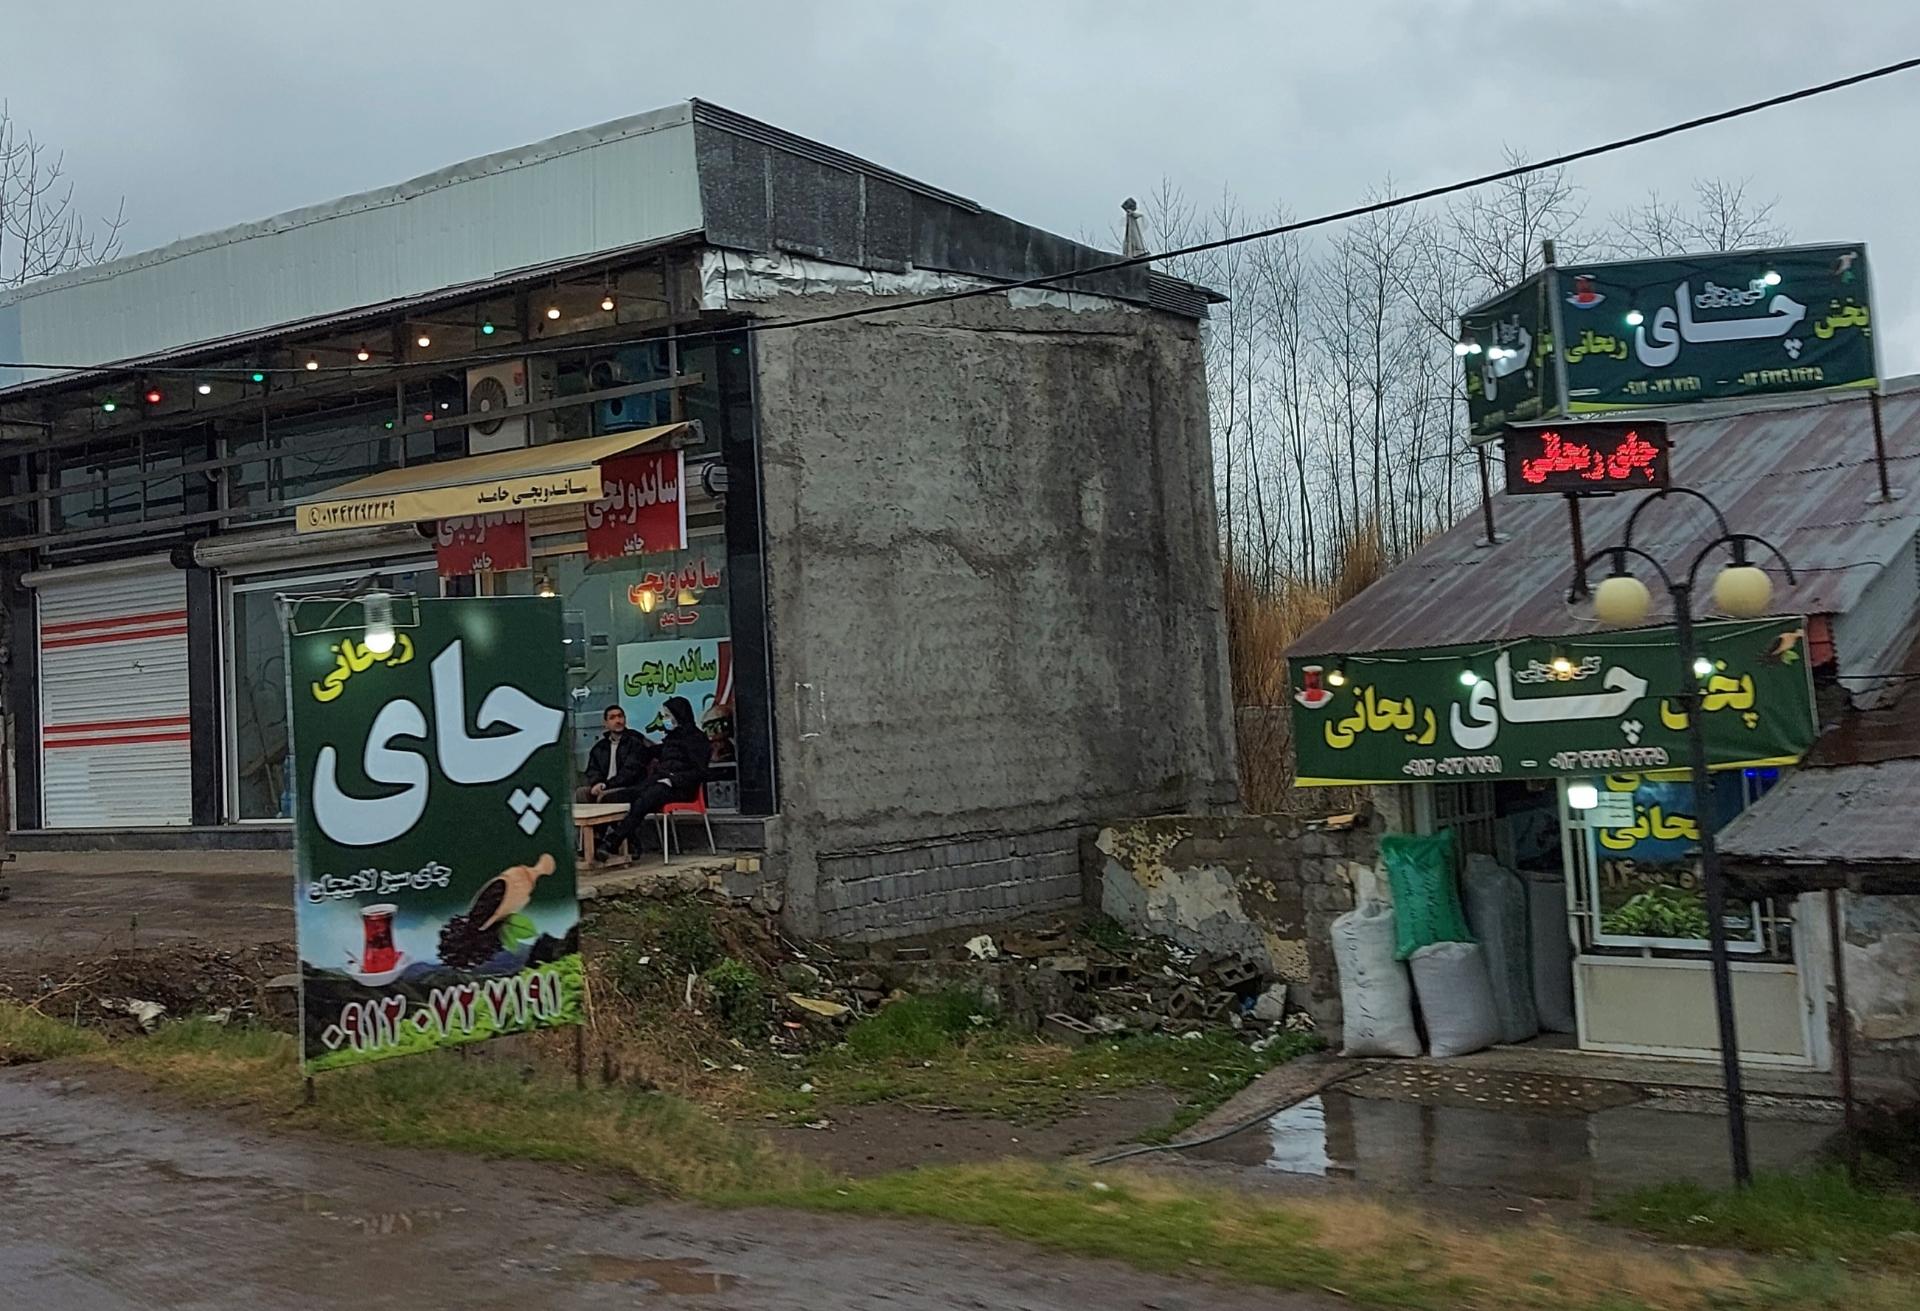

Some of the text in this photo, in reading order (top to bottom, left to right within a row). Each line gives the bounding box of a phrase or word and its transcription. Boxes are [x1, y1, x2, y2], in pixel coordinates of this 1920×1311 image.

[1564, 331, 1628, 363] ریحانی
[1634, 280, 1807, 368] چای
[511, 478, 588, 505] ساندویچی
[623, 645, 717, 698] ساندویچی
[1450, 650, 1648, 750] چای
[312, 639, 566, 847] چای
[1325, 685, 1438, 749] ریحانی
